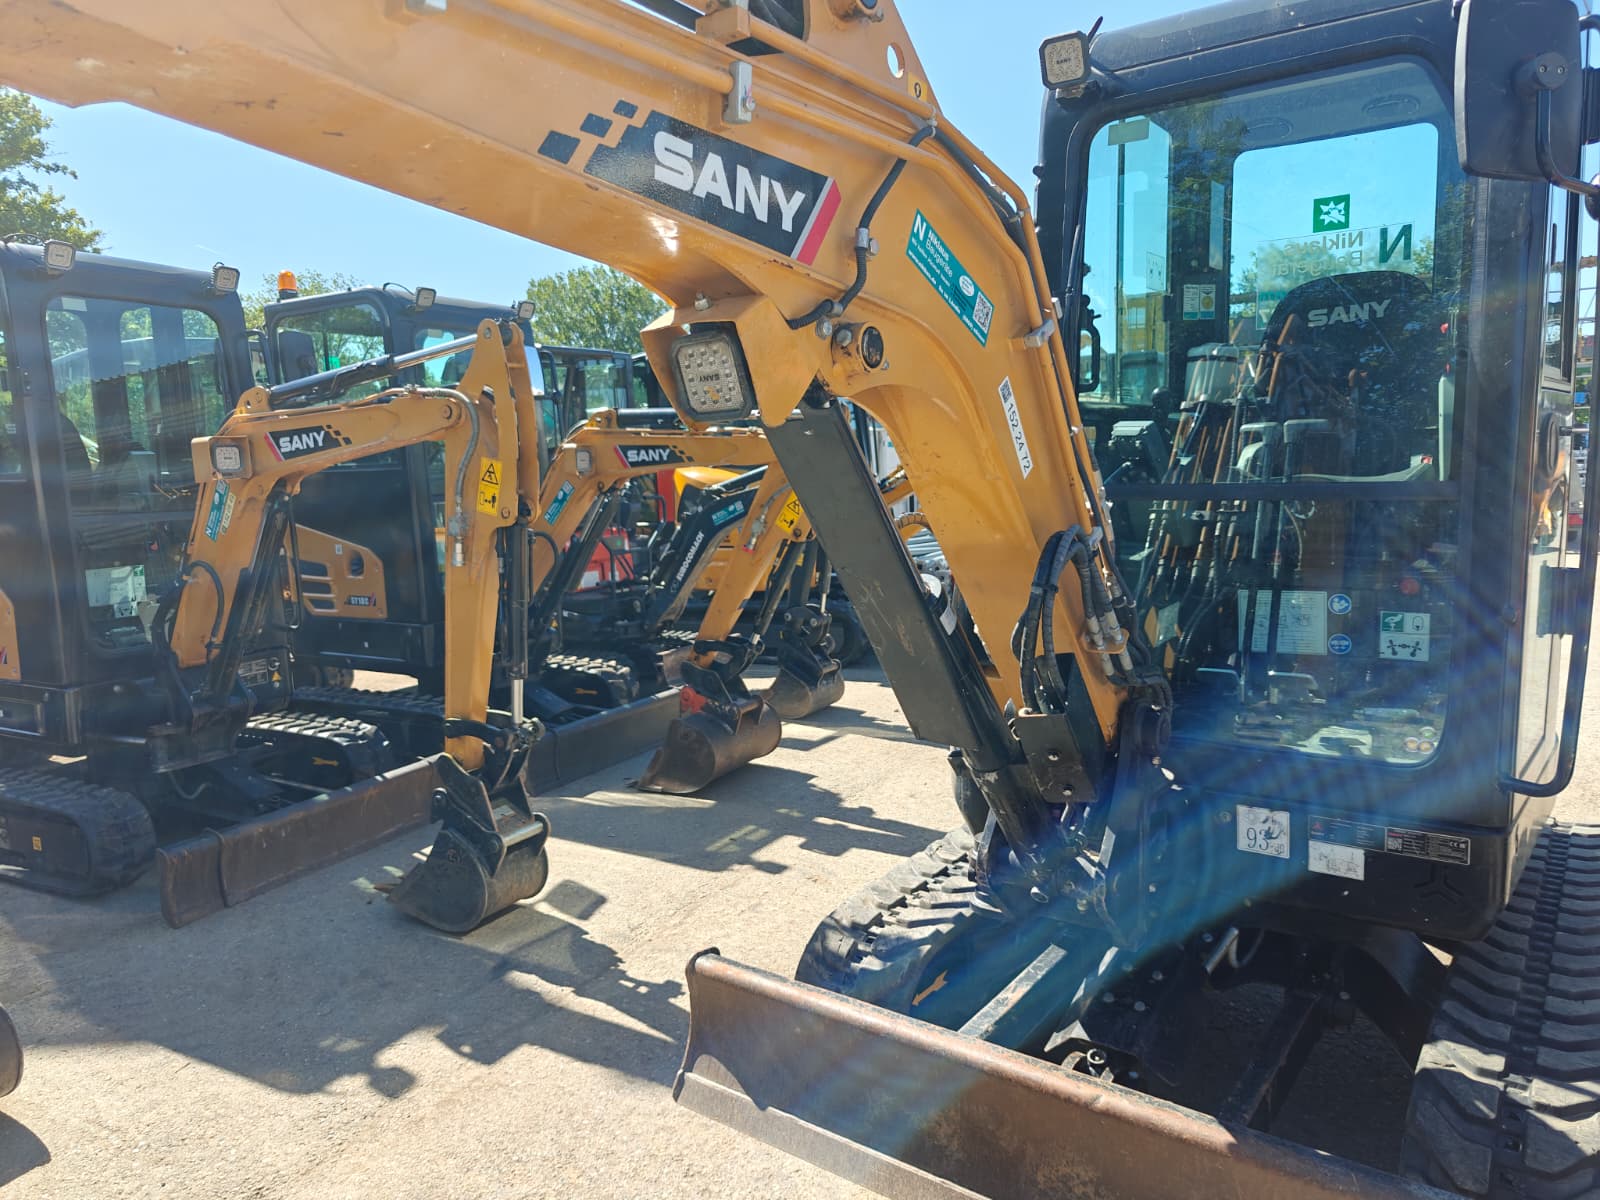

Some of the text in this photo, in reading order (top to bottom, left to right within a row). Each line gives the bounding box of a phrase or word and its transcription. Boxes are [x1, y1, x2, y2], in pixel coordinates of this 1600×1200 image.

[654, 131, 806, 233] SANY
[913, 213, 926, 241] N
[928, 229, 950, 261] Niklaus
[1308, 299, 1392, 328] SANY
[1007, 403, 1019, 431] 152
[279, 430, 326, 453] SANY
[627, 448, 670, 463] SANY
[1246, 827, 1269, 851] 93
